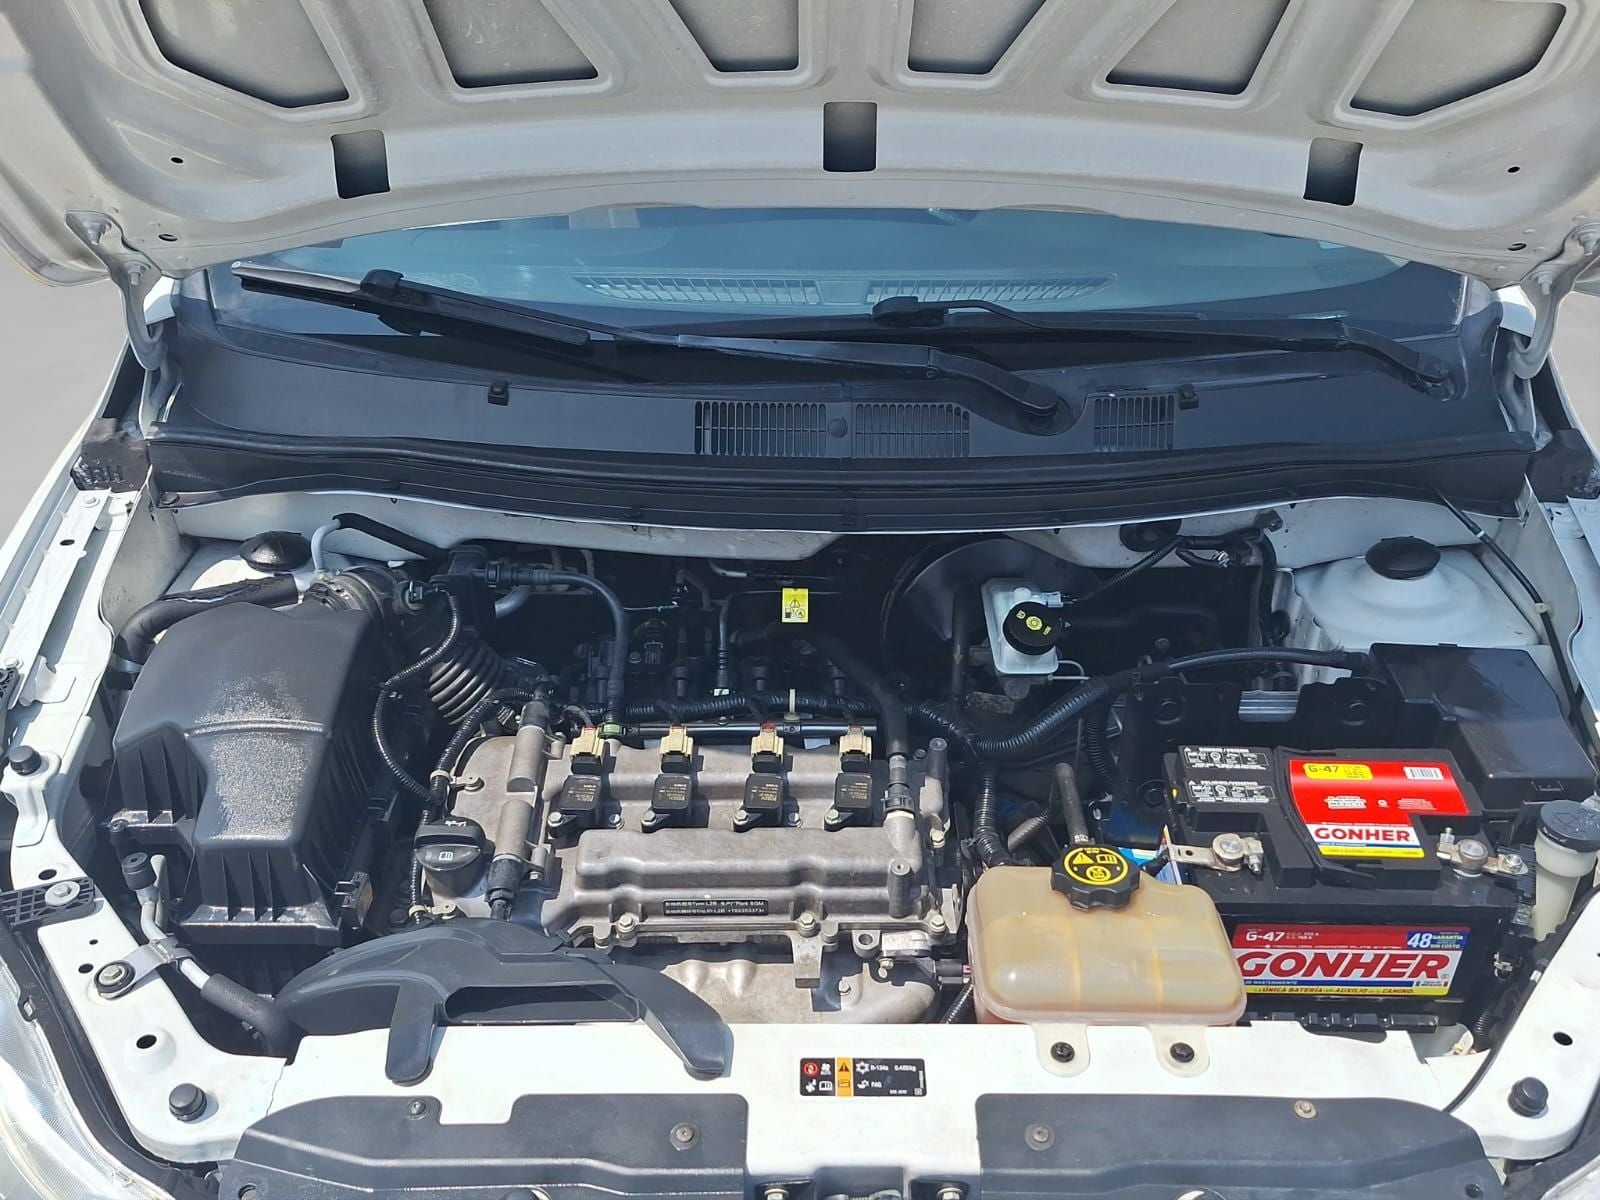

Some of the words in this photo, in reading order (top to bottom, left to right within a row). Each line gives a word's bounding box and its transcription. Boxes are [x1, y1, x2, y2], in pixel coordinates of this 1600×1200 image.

[1308, 764, 1339, 774] G-47
[1314, 827, 1410, 842] GONHER
[1246, 931, 1285, 942] G-47
[1407, 932, 1433, 948] 48
[1237, 951, 1450, 979] GONHER
